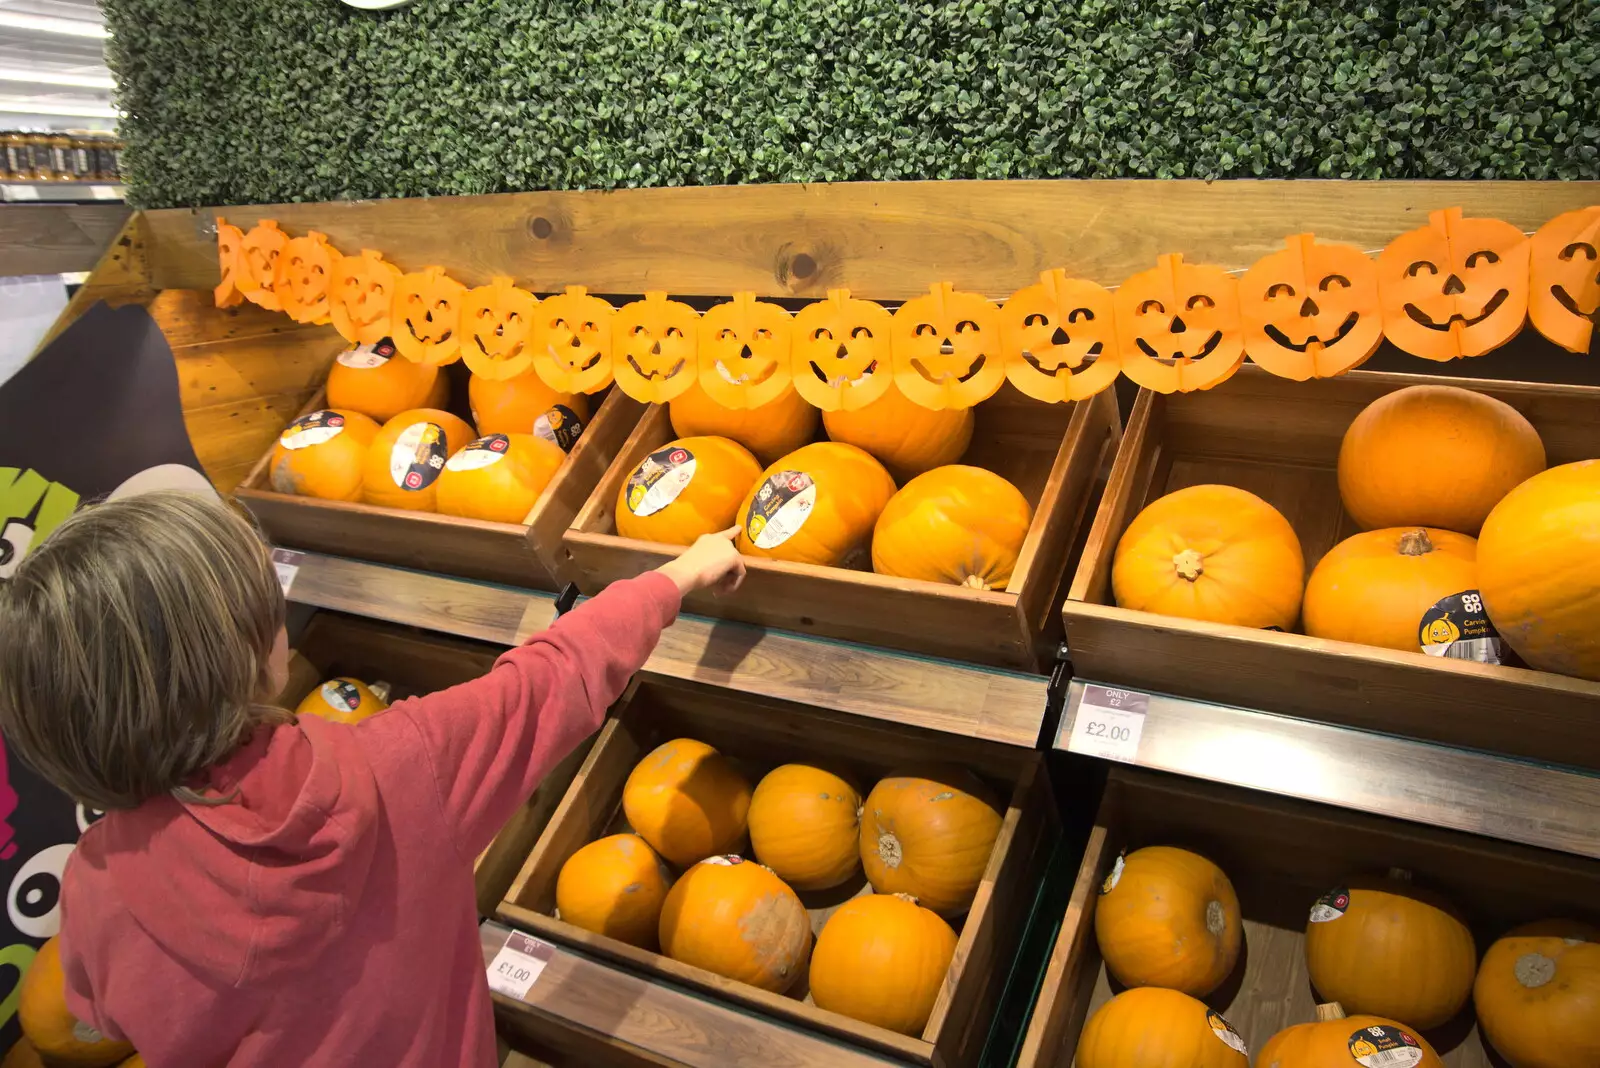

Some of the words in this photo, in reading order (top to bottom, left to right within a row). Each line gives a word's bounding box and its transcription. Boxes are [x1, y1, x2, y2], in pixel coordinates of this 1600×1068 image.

[1105, 689, 1130, 700] ONLY
[1109, 698, 1122, 707] £2
[1085, 721, 1131, 742] £2.00
[497, 961, 531, 982] £1.00
